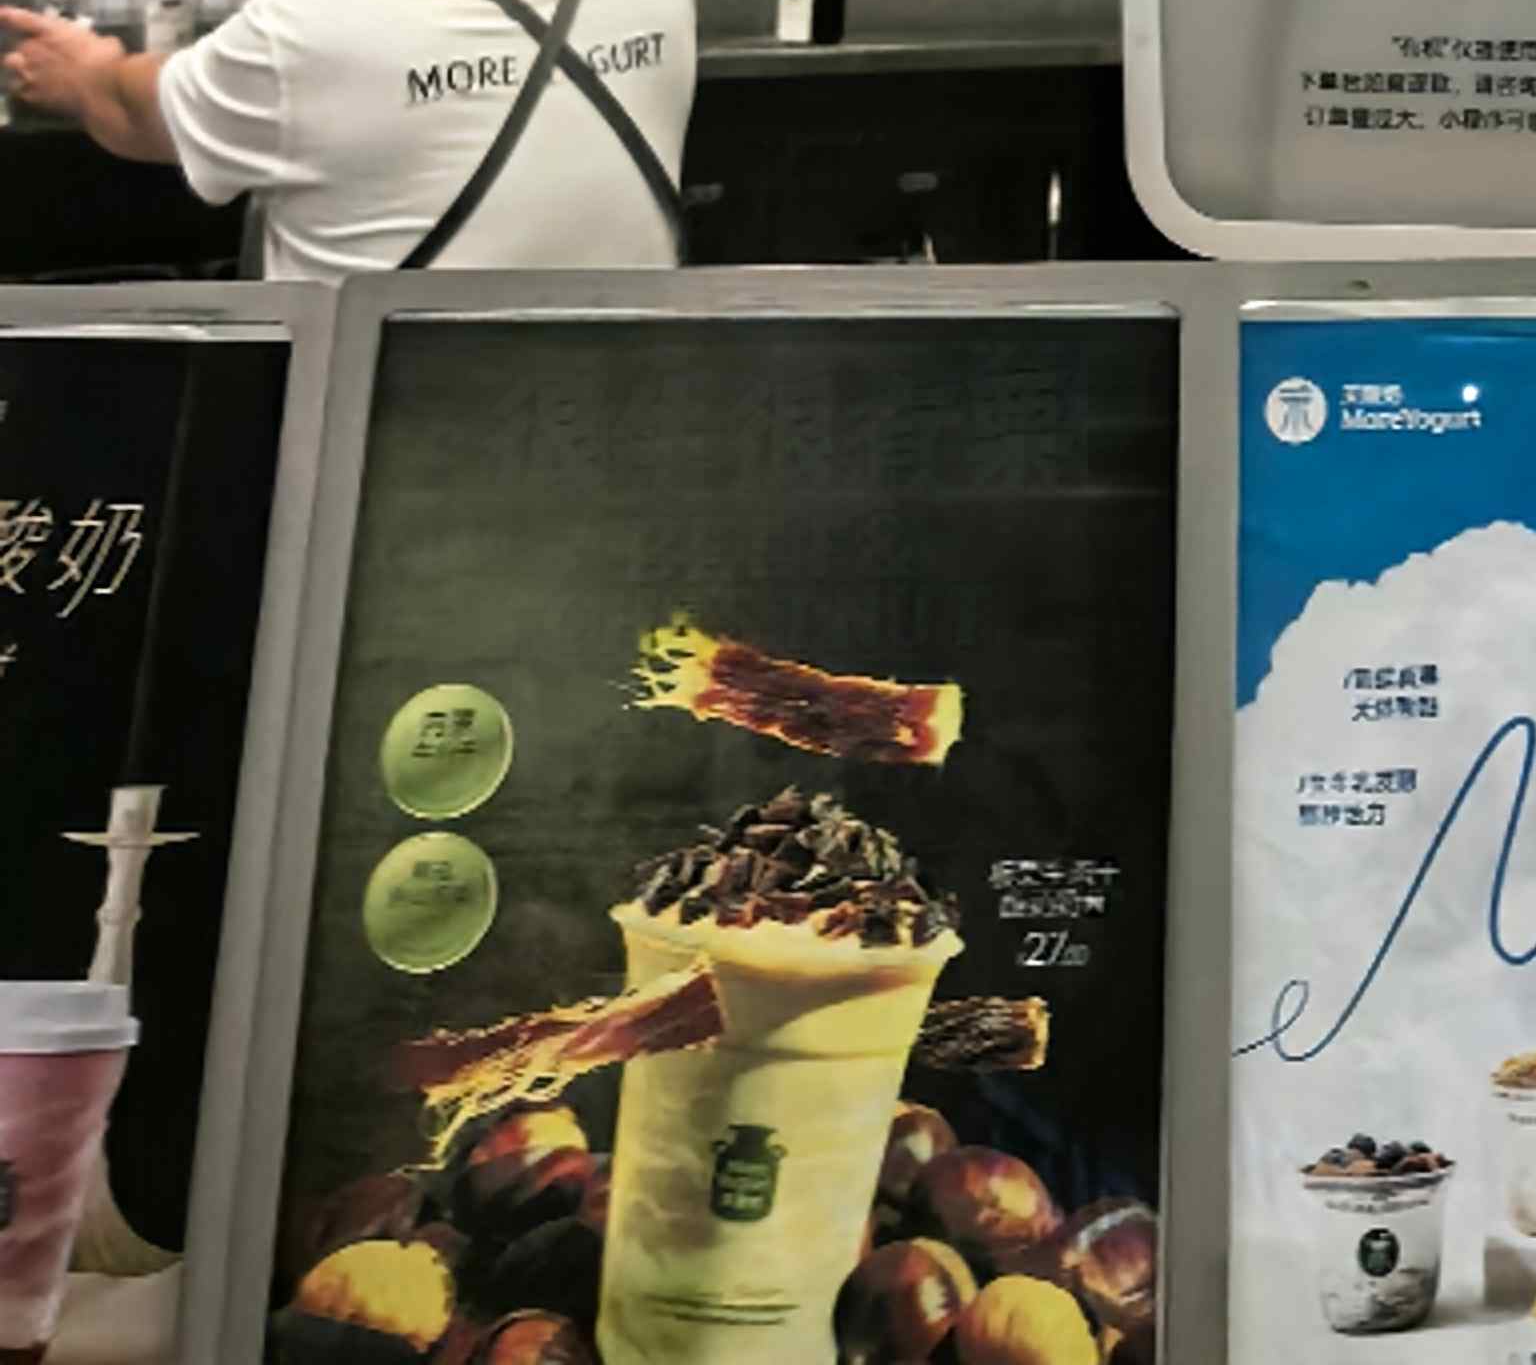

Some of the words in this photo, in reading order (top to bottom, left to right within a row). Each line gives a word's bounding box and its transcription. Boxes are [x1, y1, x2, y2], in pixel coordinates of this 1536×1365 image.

[406, 55, 520, 105] MORE
[586, 31, 667, 77] GURT
[1340, 407, 1483, 435] MoreYogurt
